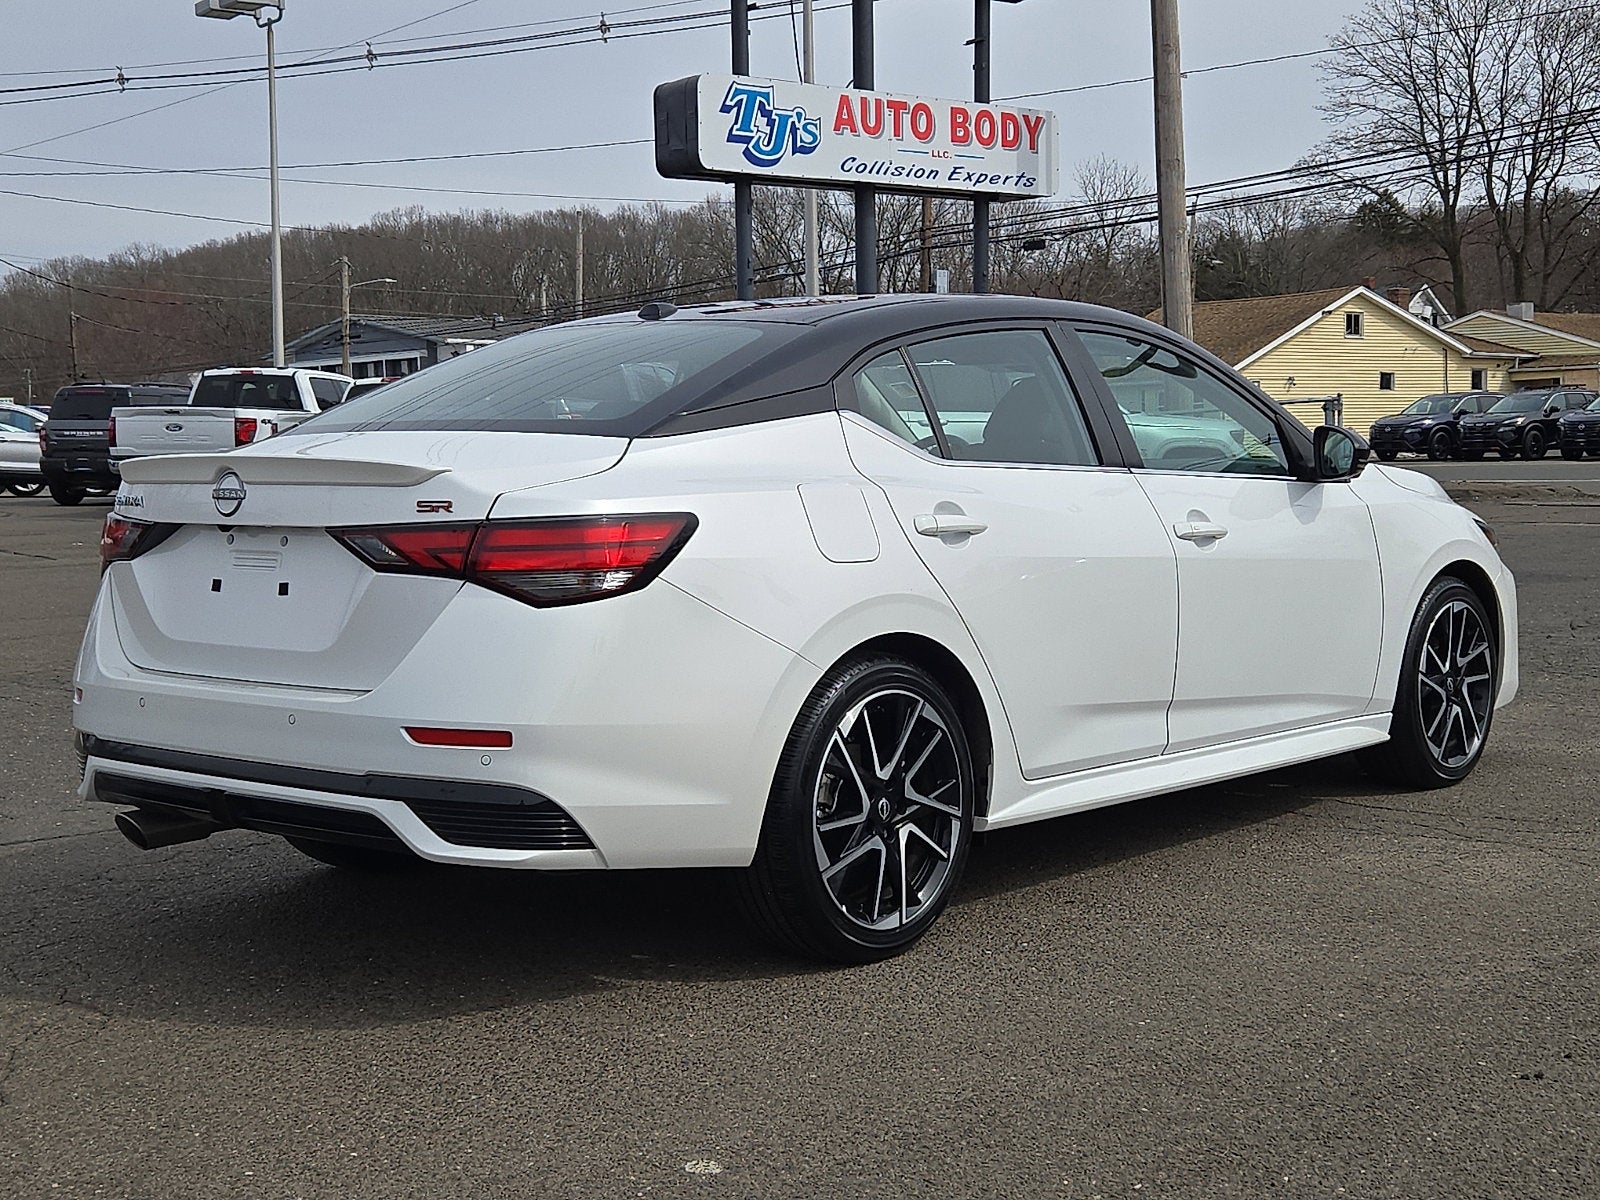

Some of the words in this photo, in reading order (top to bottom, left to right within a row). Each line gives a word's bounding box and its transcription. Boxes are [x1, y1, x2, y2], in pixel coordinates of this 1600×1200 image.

[833, 94, 935, 144] AUTO
[950, 106, 1045, 154] BODY
[931, 149, 953, 159] LLC.
[840, 156, 940, 180] Collision
[947, 165, 1037, 188] Experts
[416, 500, 453, 513] SR
